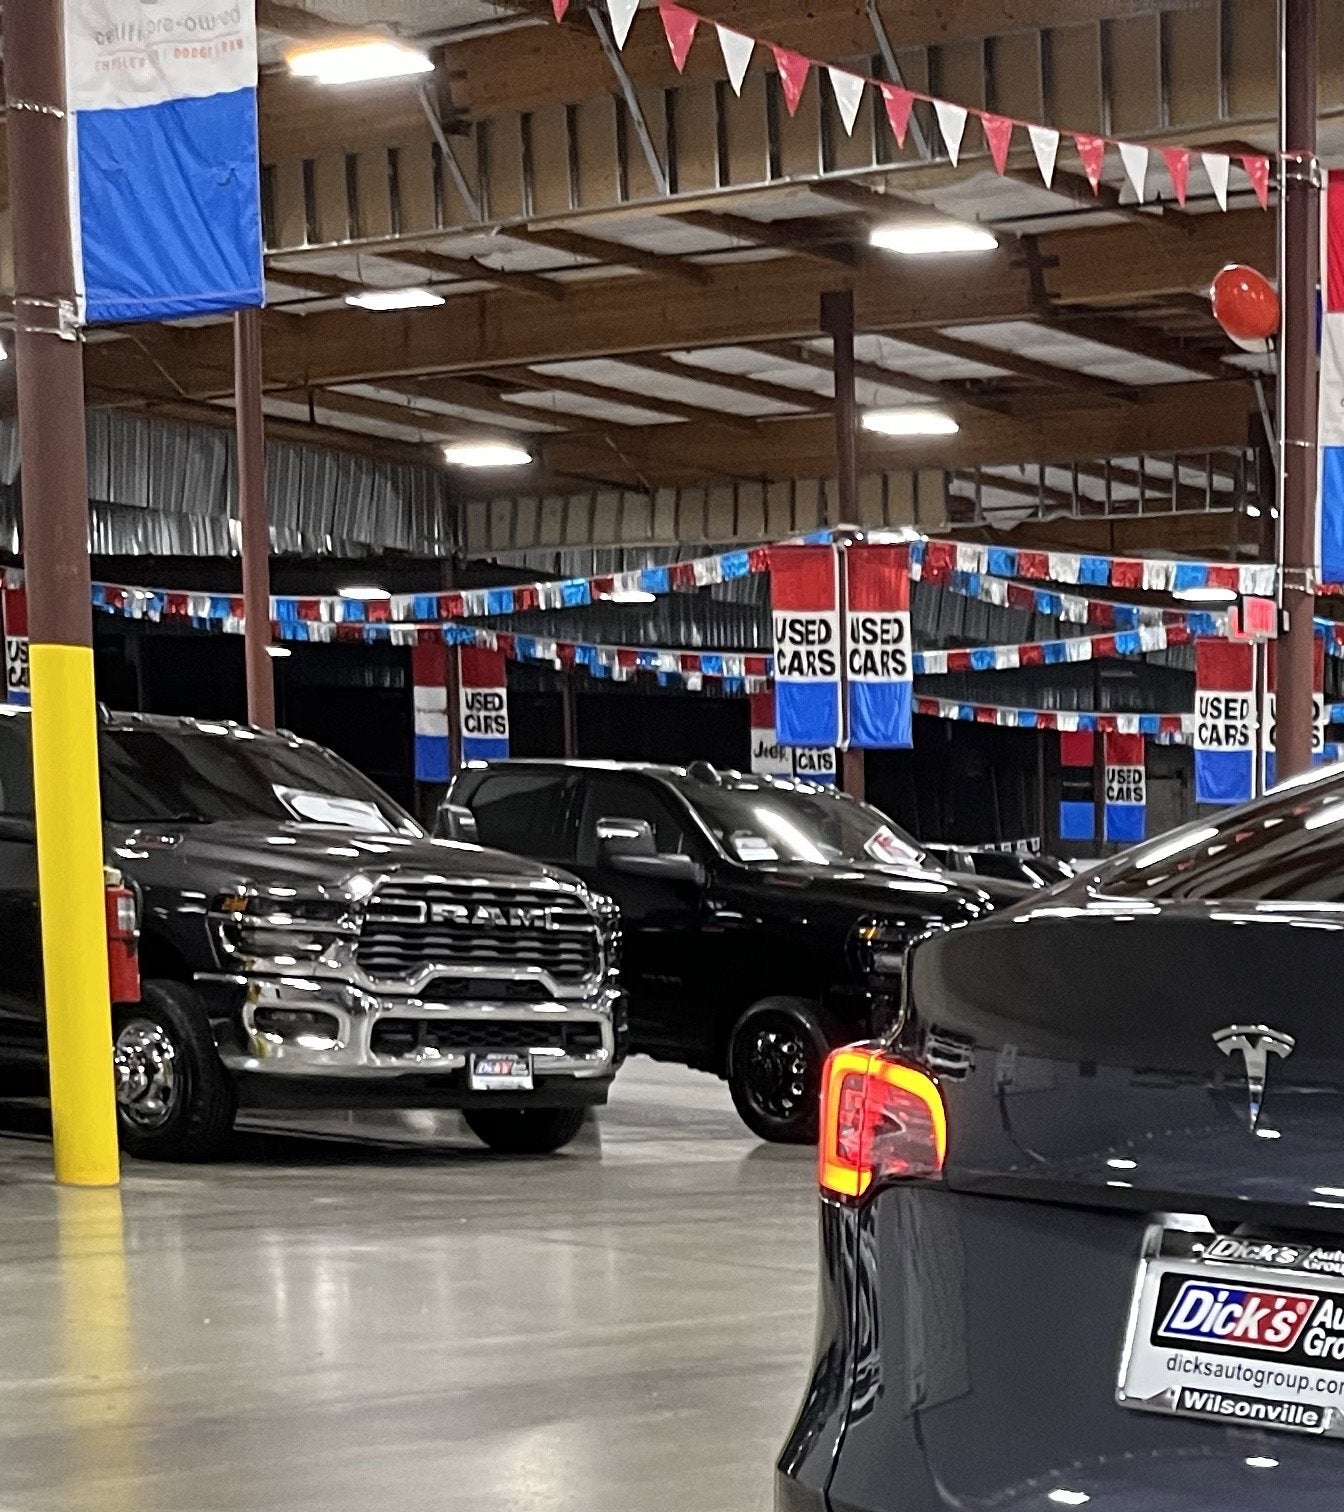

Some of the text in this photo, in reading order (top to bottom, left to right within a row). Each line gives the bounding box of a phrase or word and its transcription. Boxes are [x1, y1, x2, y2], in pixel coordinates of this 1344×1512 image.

[775, 617, 832, 645] USED
[850, 617, 904, 645] USED
[7, 641, 29, 663] US
[777, 648, 836, 676] CARS
[849, 648, 907, 676] CARS
[9, 666, 30, 687] CA
[465, 692, 504, 712] USED
[1199, 697, 1249, 720] USED
[1271, 698, 1320, 722] UD
[1198, 722, 1249, 746] CARS
[1269, 724, 1320, 748] CS
[1107, 768, 1142, 784] USED
[430, 903, 545, 927] RAM
[1170, 1289, 1298, 1343] Dick's
[1182, 1390, 1319, 1426] Wilsonville
